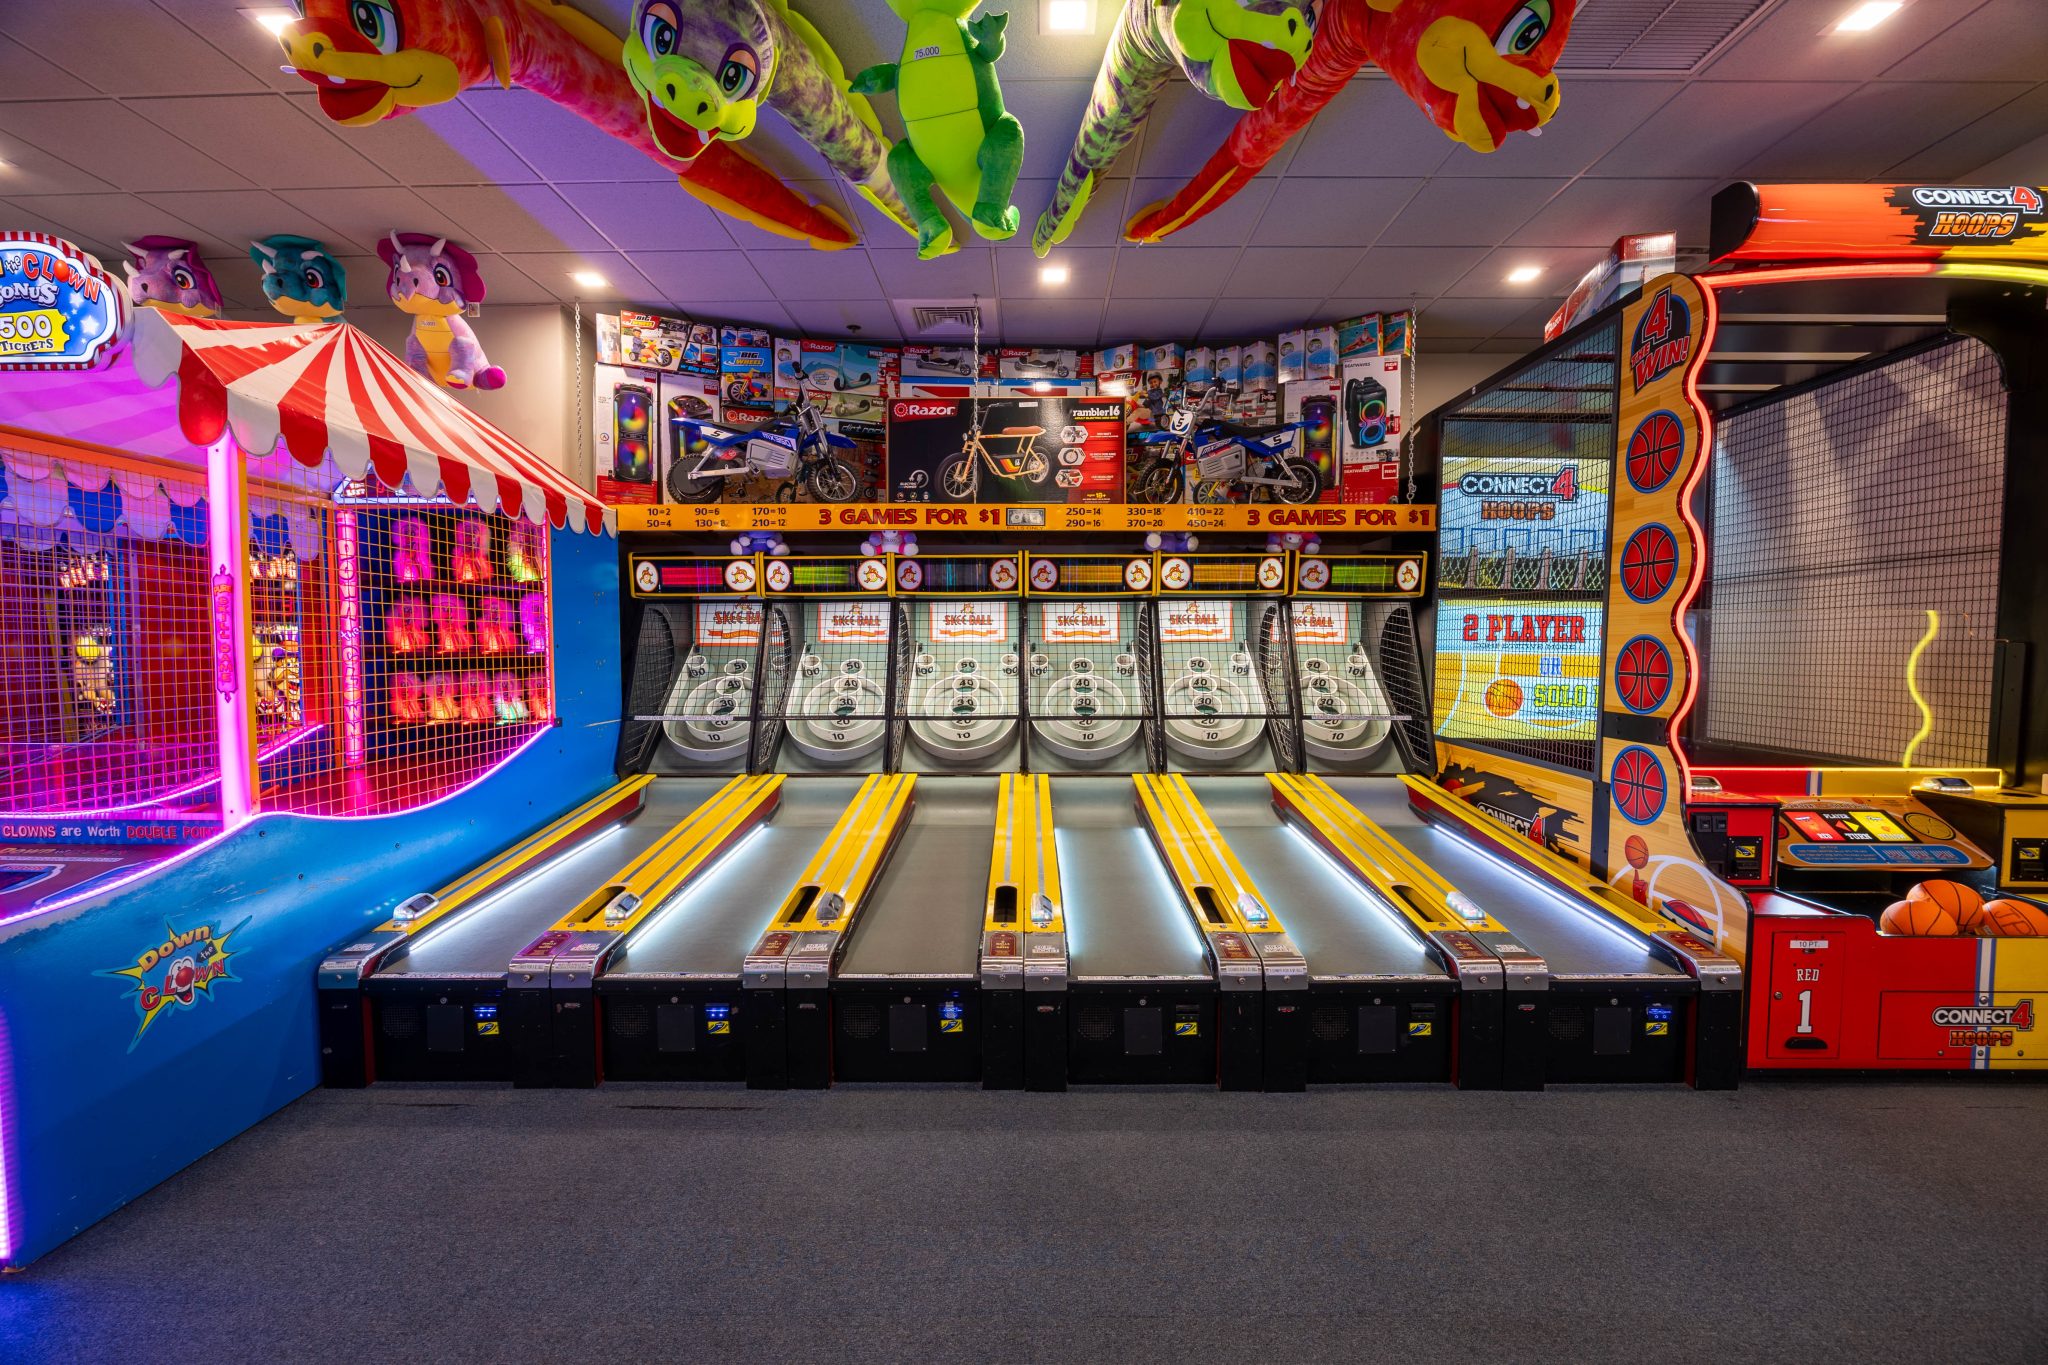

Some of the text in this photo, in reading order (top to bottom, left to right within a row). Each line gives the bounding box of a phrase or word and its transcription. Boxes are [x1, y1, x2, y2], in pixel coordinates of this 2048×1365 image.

[1916, 187, 2039, 210] CONNECT 4
[1932, 214, 2017, 236] HOOPS
[5, 252, 101, 303] the CLOWN
[0, 282, 59, 307] ONUS
[1644, 294, 1668, 339] 4
[0, 338, 54, 352] TICKETS
[1631, 342, 1650, 366] THE
[1636, 336, 1690, 390] WIN!
[908, 404, 954, 416] Razor
[1072, 406, 1120, 416] rambler16
[1462, 468, 1576, 500] CONNECT 4
[647, 508, 671, 516] 10=2
[694, 508, 720, 516] 90=6
[752, 507, 786, 515] 170=10
[819, 508, 1000, 525] 3 GAMES FOR $1
[1066, 508, 1101, 516] 250=14
[1248, 510, 1430, 526] 3 GAMES FOR $1
[1482, 502, 1555, 520] HOOPS
[646, 520, 672, 528] 50=4
[752, 519, 786, 527] 210=12
[1464, 614, 1585, 643] 2 PLAYER
[846, 662, 860, 670] 50
[1307, 661, 1320, 669] 50
[1540, 657, 1562, 676] OR
[1534, 684, 1587, 707] SOLO
[3, 825, 56, 837] CLOWNS
[61, 827, 82, 837] are
[88, 826, 120, 837] Worth
[127, 826, 177, 839] DOUBLE
[138, 926, 212, 972] Down
[200, 945, 214, 959] the
[1797, 968, 1820, 981] RED
[140, 959, 224, 1010] CLOWN
[1797, 990, 1812, 1033] 1
[1935, 1002, 2030, 1028] CONNECT 4
[1950, 1031, 2012, 1046] HOOPS
